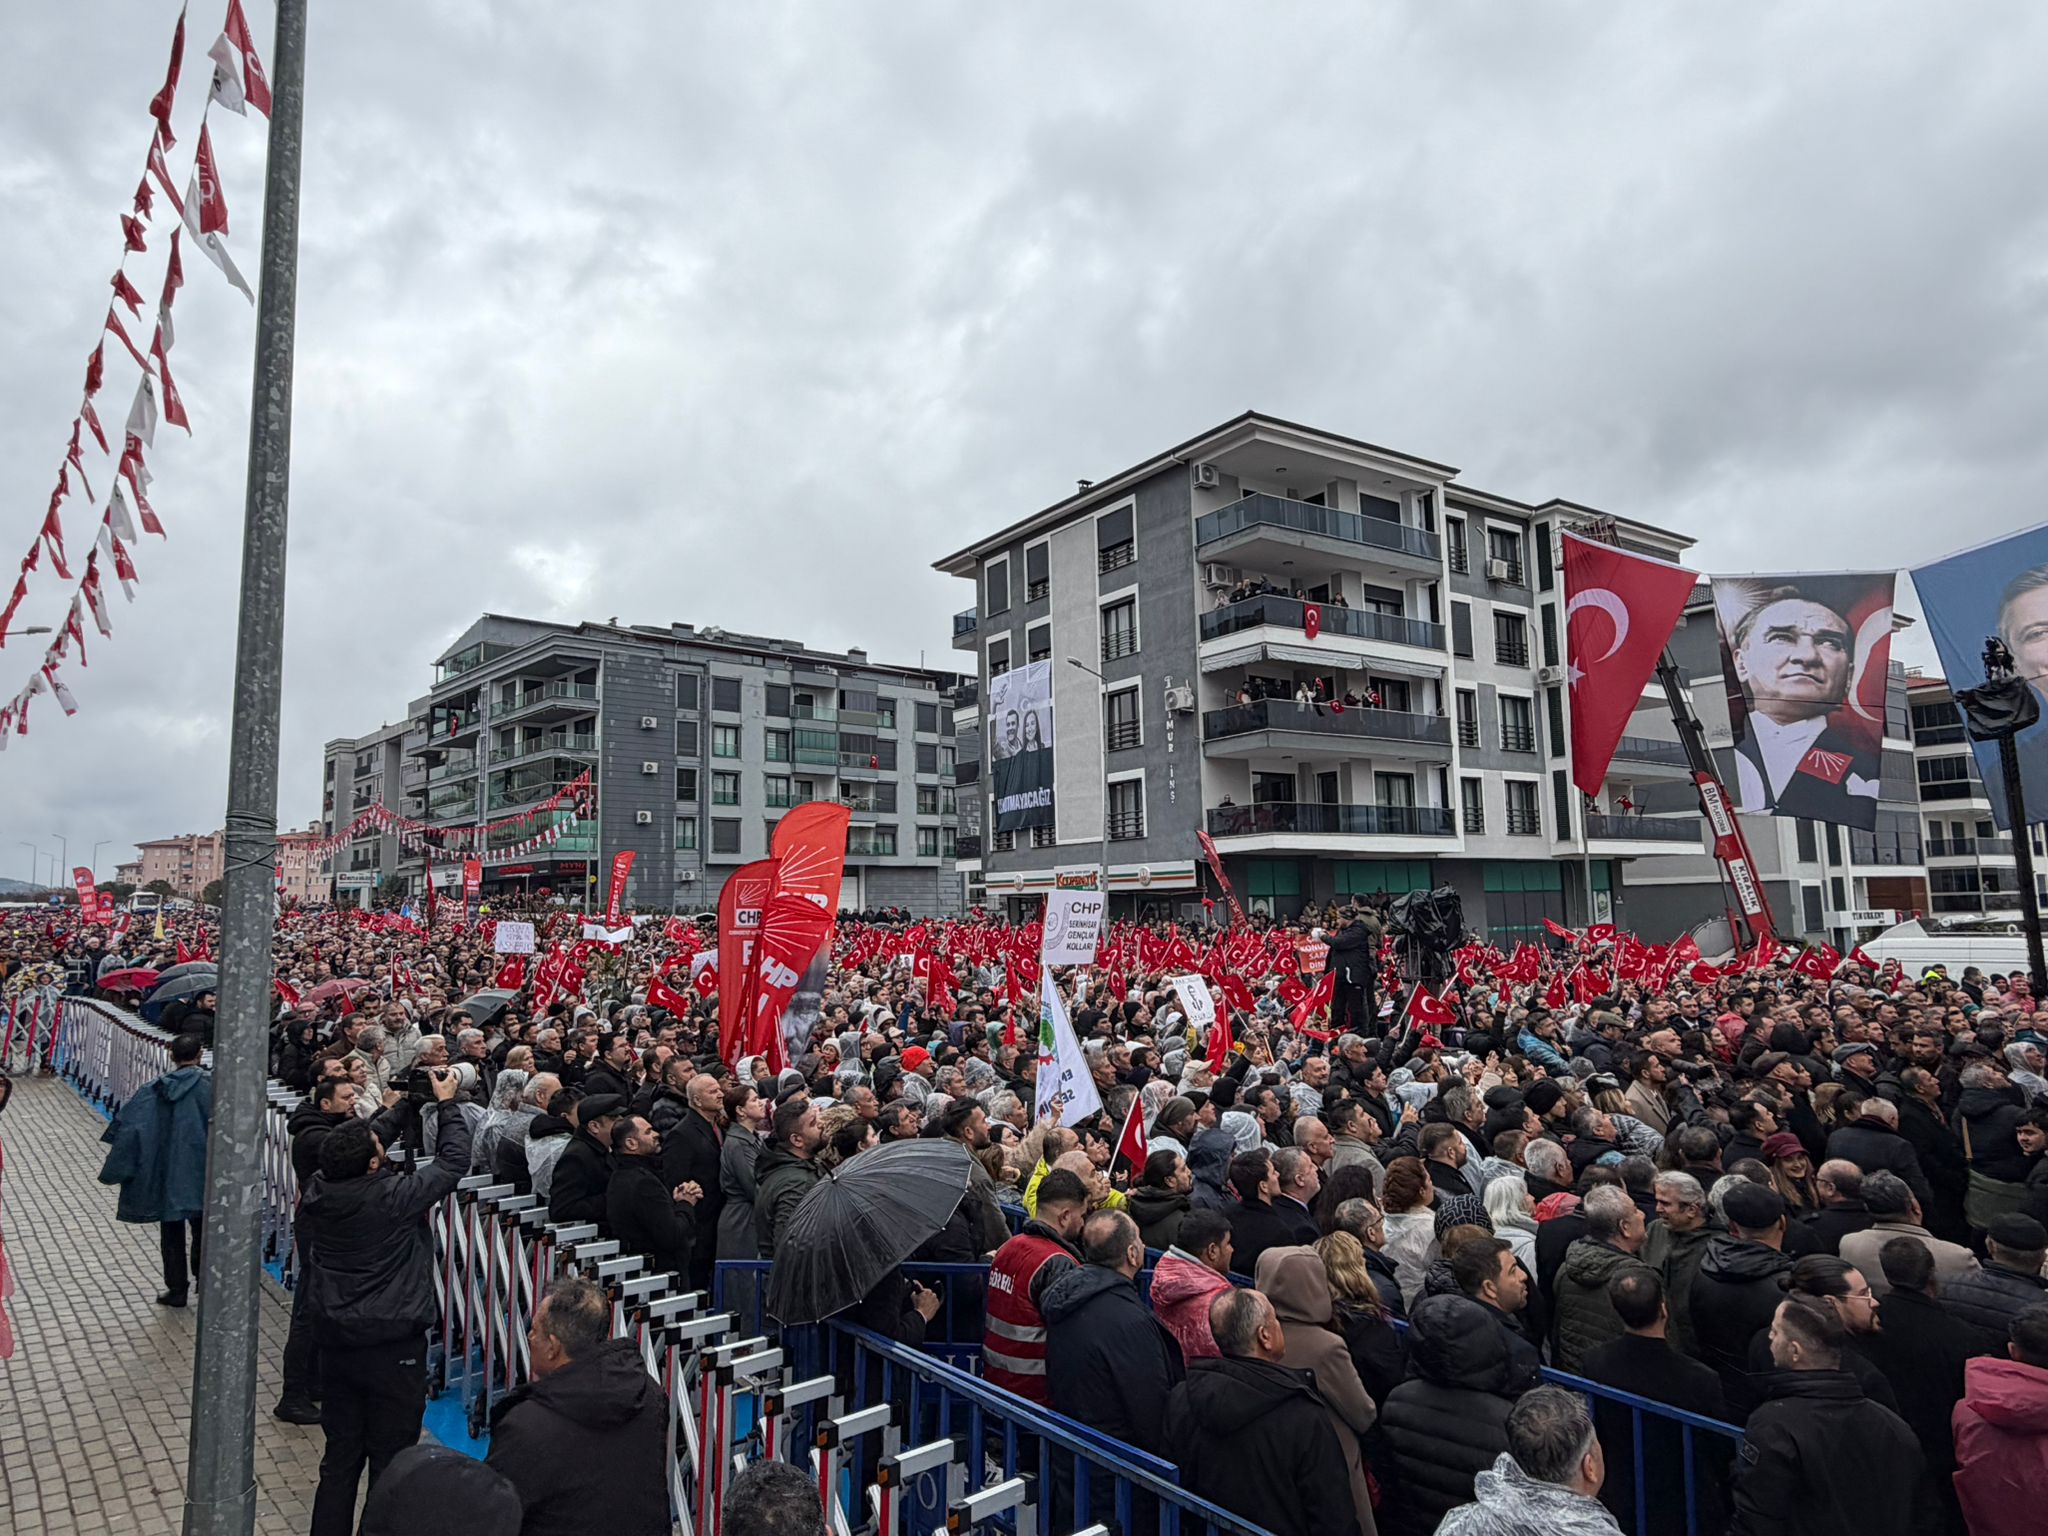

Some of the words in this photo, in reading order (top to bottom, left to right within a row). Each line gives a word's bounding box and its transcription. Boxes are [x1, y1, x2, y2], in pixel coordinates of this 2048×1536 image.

[1703, 787, 1717, 805] BM
[1071, 902, 1101, 914] CHP
[760, 955, 799, 989] HP
